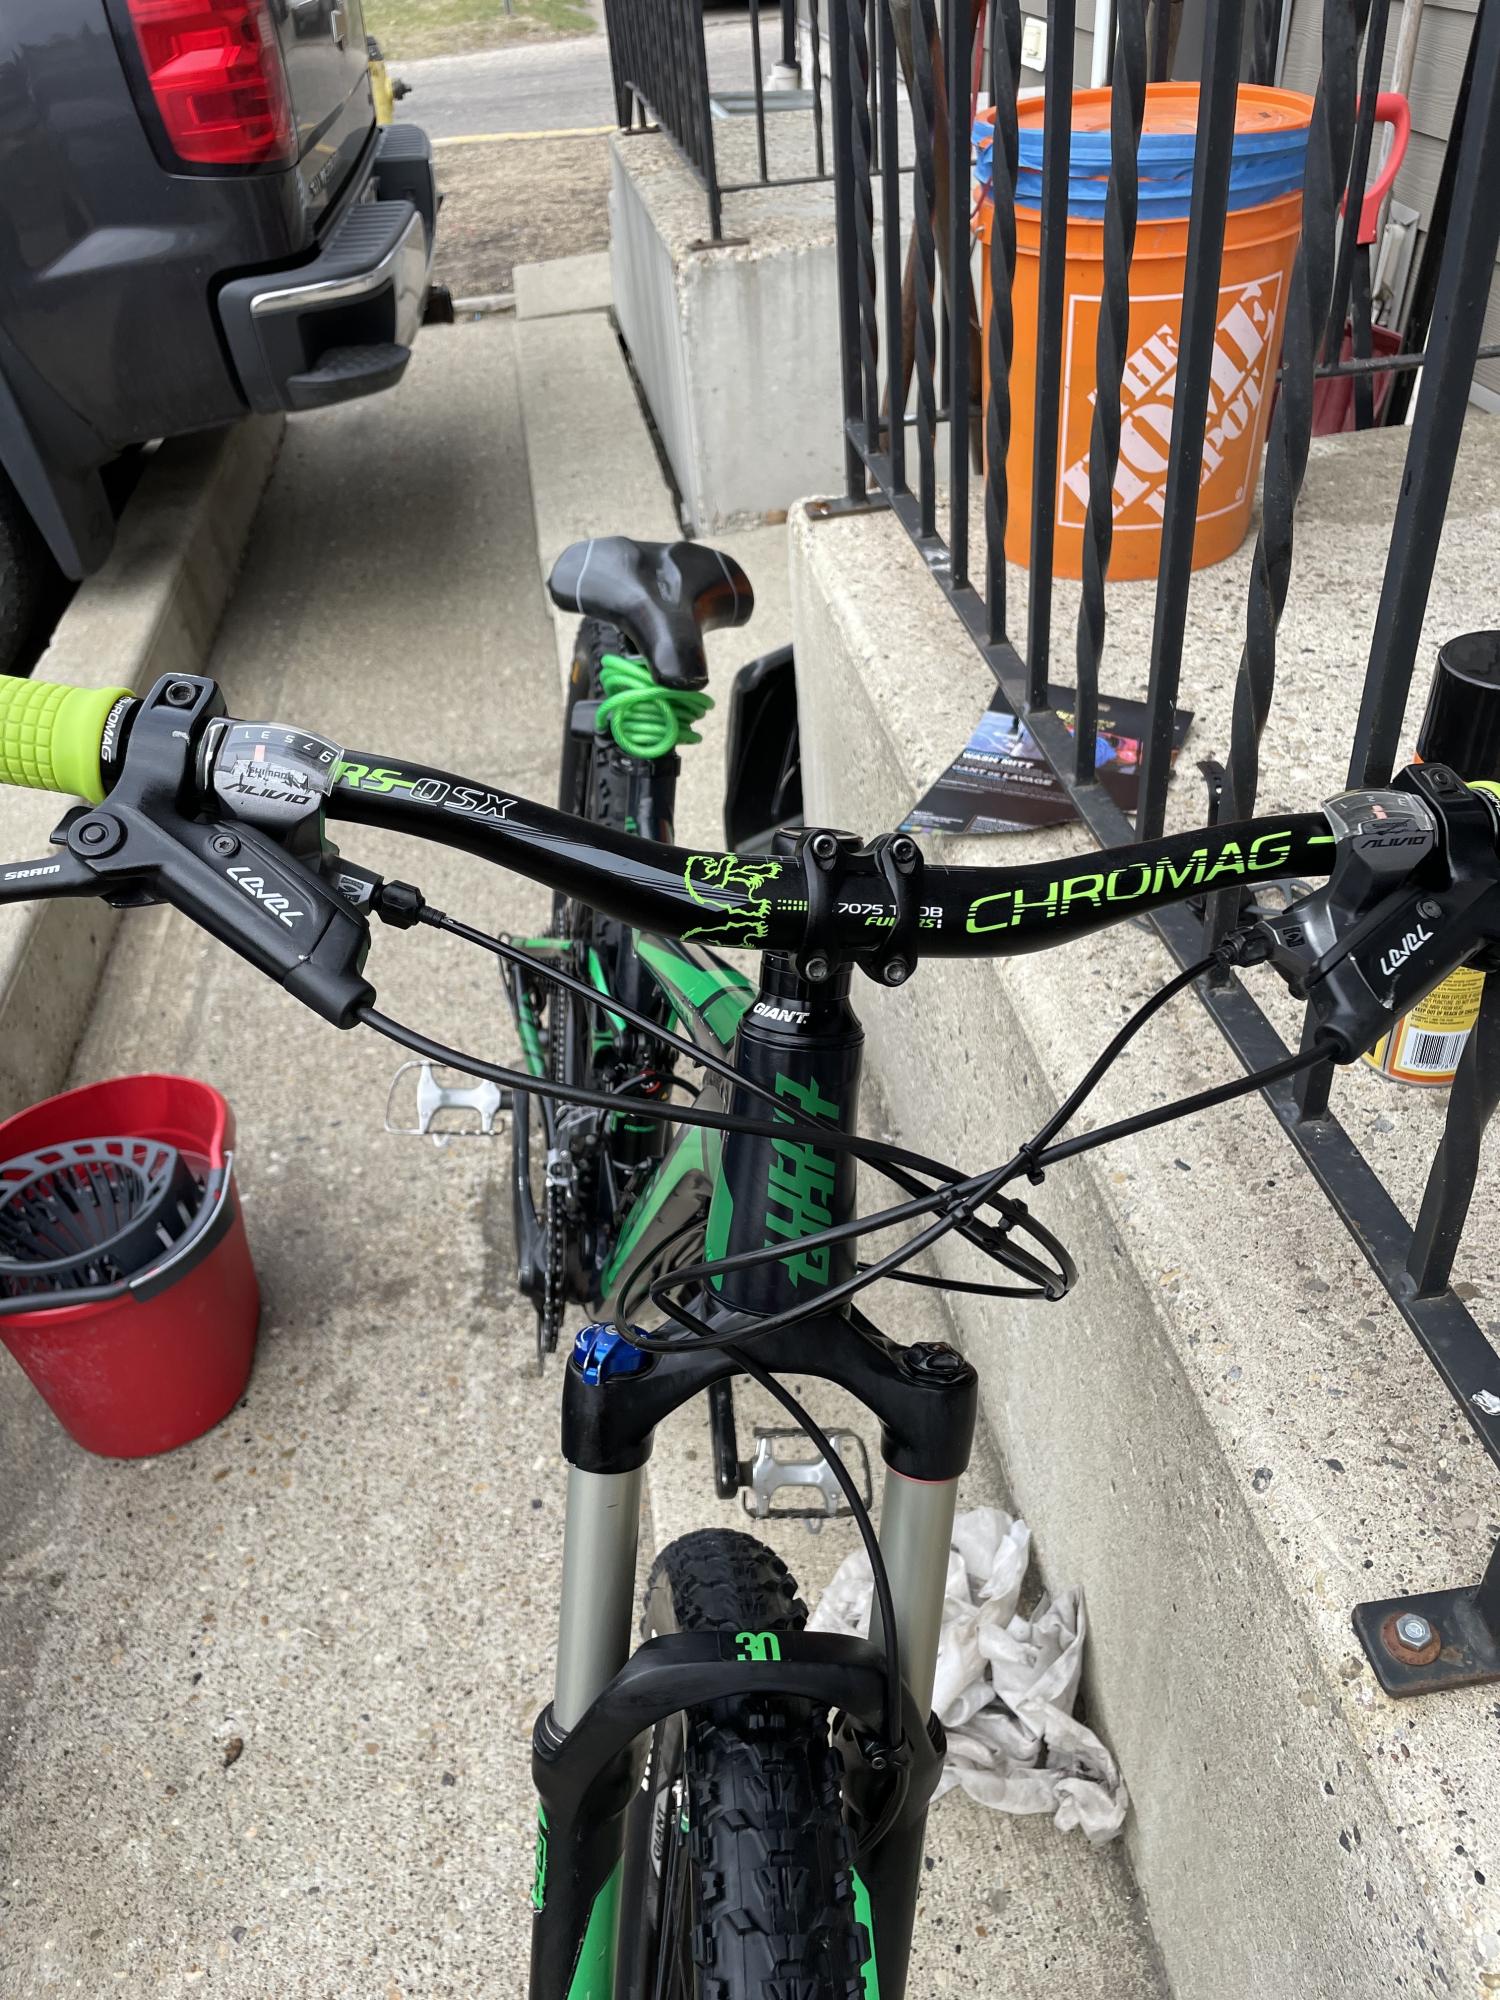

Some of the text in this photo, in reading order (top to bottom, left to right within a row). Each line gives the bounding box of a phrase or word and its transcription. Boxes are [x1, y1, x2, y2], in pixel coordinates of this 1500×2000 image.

[1087, 323, 1179, 416] HE
[1144, 367, 1261, 520] POT
[223, 783, 312, 805] ALIVIO
[1360, 836, 1427, 849] ALIVIO
[4, 864, 61, 881] SRAM
[965, 831, 1292, 934] CHROMAG
[838, 902, 884, 915] 7075
[735, 1631, 781, 1661] 30
